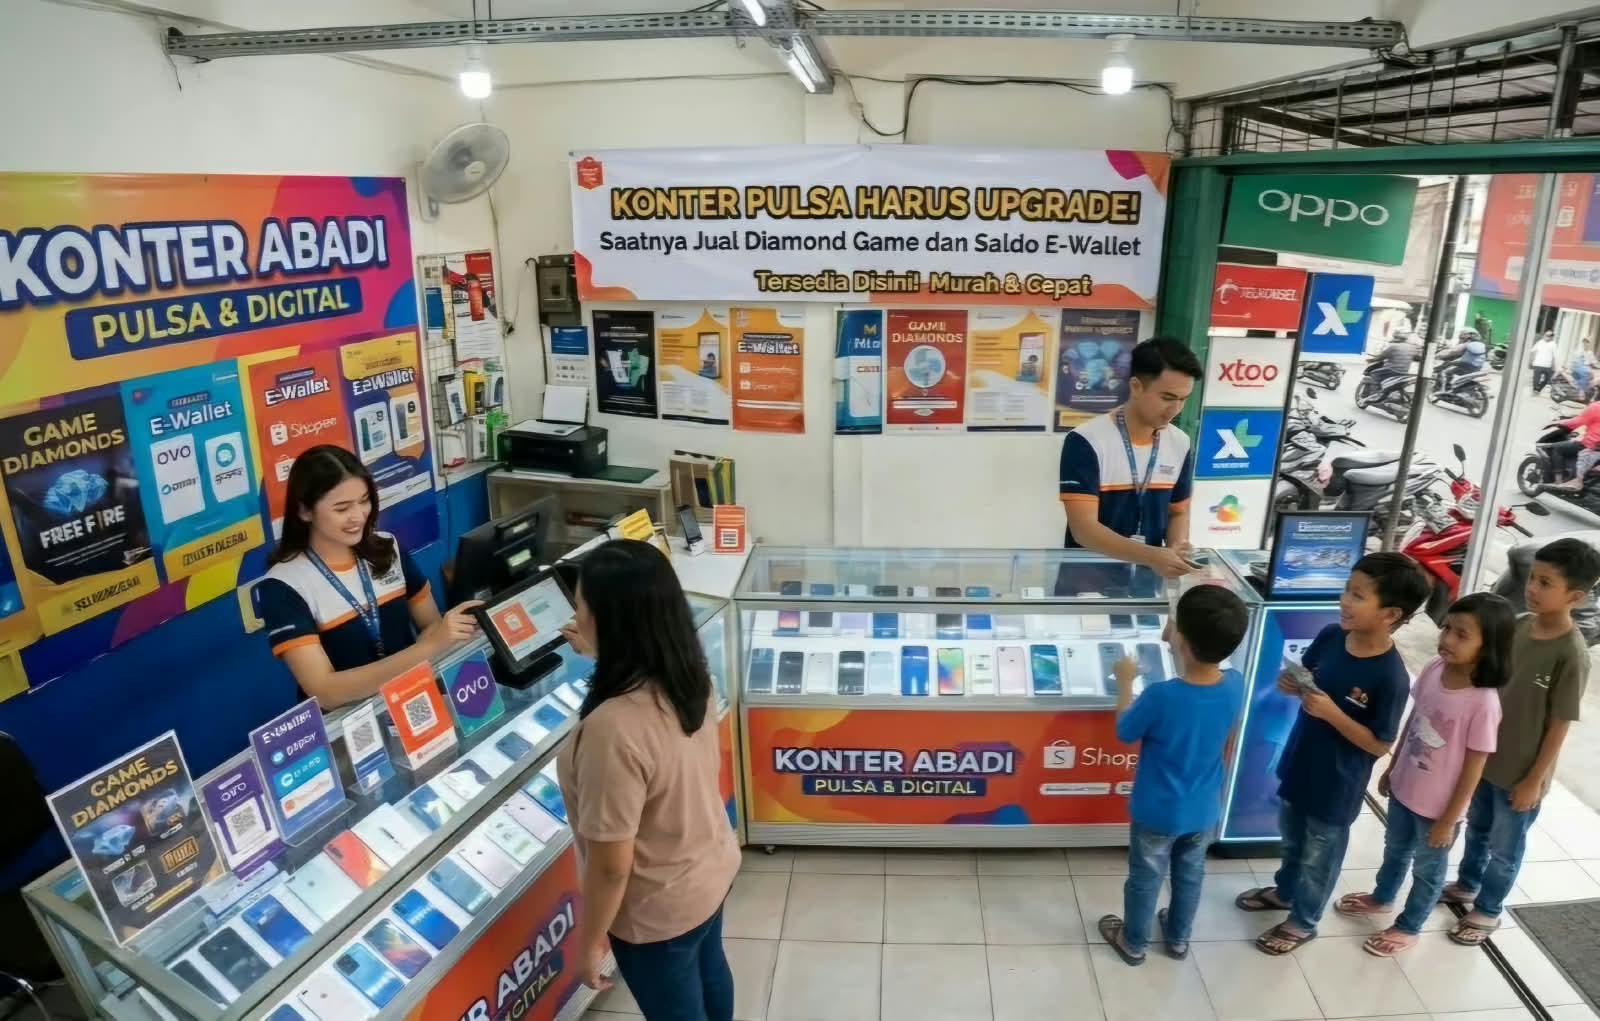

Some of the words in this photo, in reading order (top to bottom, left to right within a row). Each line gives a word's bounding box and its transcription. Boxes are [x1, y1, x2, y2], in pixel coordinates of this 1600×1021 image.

[611, 186, 740, 220] KONTER
[745, 186, 852, 219] PULSA
[856, 186, 970, 219] HARUS
[976, 187, 1141, 224] UPGRADE!
[0, 222, 250, 303] KONTER
[258, 218, 389, 275] ABADI
[600, 231, 687, 255] Saatnya
[692, 231, 739, 251] Jual
[745, 231, 846, 251] Diamond
[853, 232, 919, 252] Game
[926, 232, 968, 252] dan
[974, 233, 1039, 253] Saldo
[1045, 234, 1141, 255] E-Wallet
[755, 271, 849, 292] Tersedia
[930, 272, 1000, 294] Murah
[1004, 272, 1021, 295] &
[92, 302, 211, 349] PULSA
[218, 298, 239, 327] &
[247, 285, 351, 324] DIGITAL
[24, 412, 97, 447] GAME
[149, 401, 233, 436] E-Wallet
[5, 428, 125, 475] DIAMONDS
[157, 445, 191, 465] OVO
[40, 519, 83, 550] FREE
[457, 675, 489, 703] OVO
[774, 748, 904, 773] KONTER
[912, 751, 1014, 773] ABADI
[71, 760, 179, 829] DIAMONDS
[815, 779, 877, 794] PULSA
[901, 780, 977, 795] DIGITAL
[498, 902, 575, 1009] ABADI
